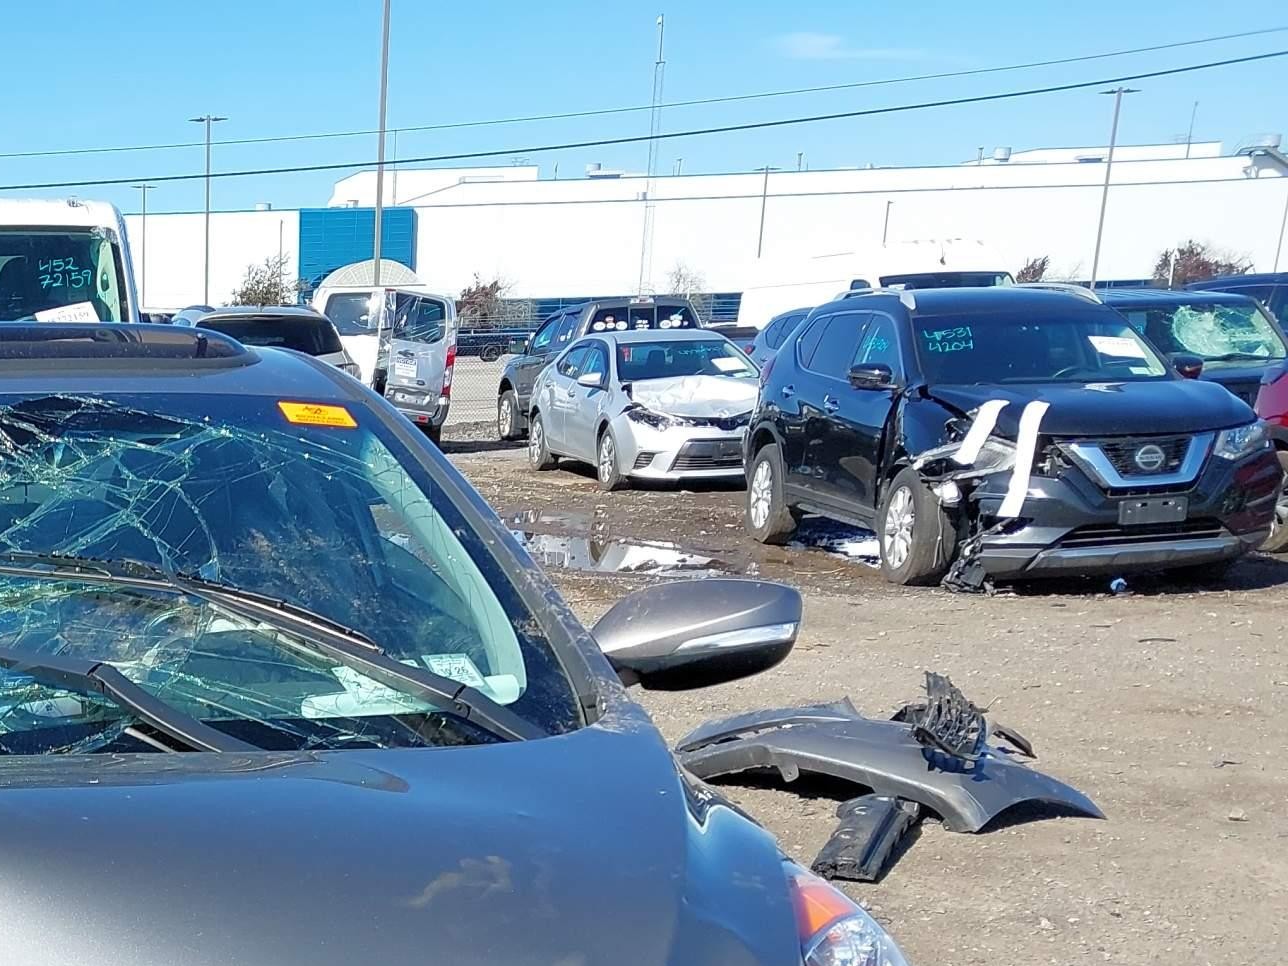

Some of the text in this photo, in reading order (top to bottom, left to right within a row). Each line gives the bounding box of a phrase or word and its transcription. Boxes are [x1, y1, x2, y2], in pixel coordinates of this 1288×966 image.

[39, 257, 79, 272] 452
[38, 270, 92, 289] 72159
[928, 339, 973, 352] 4204
